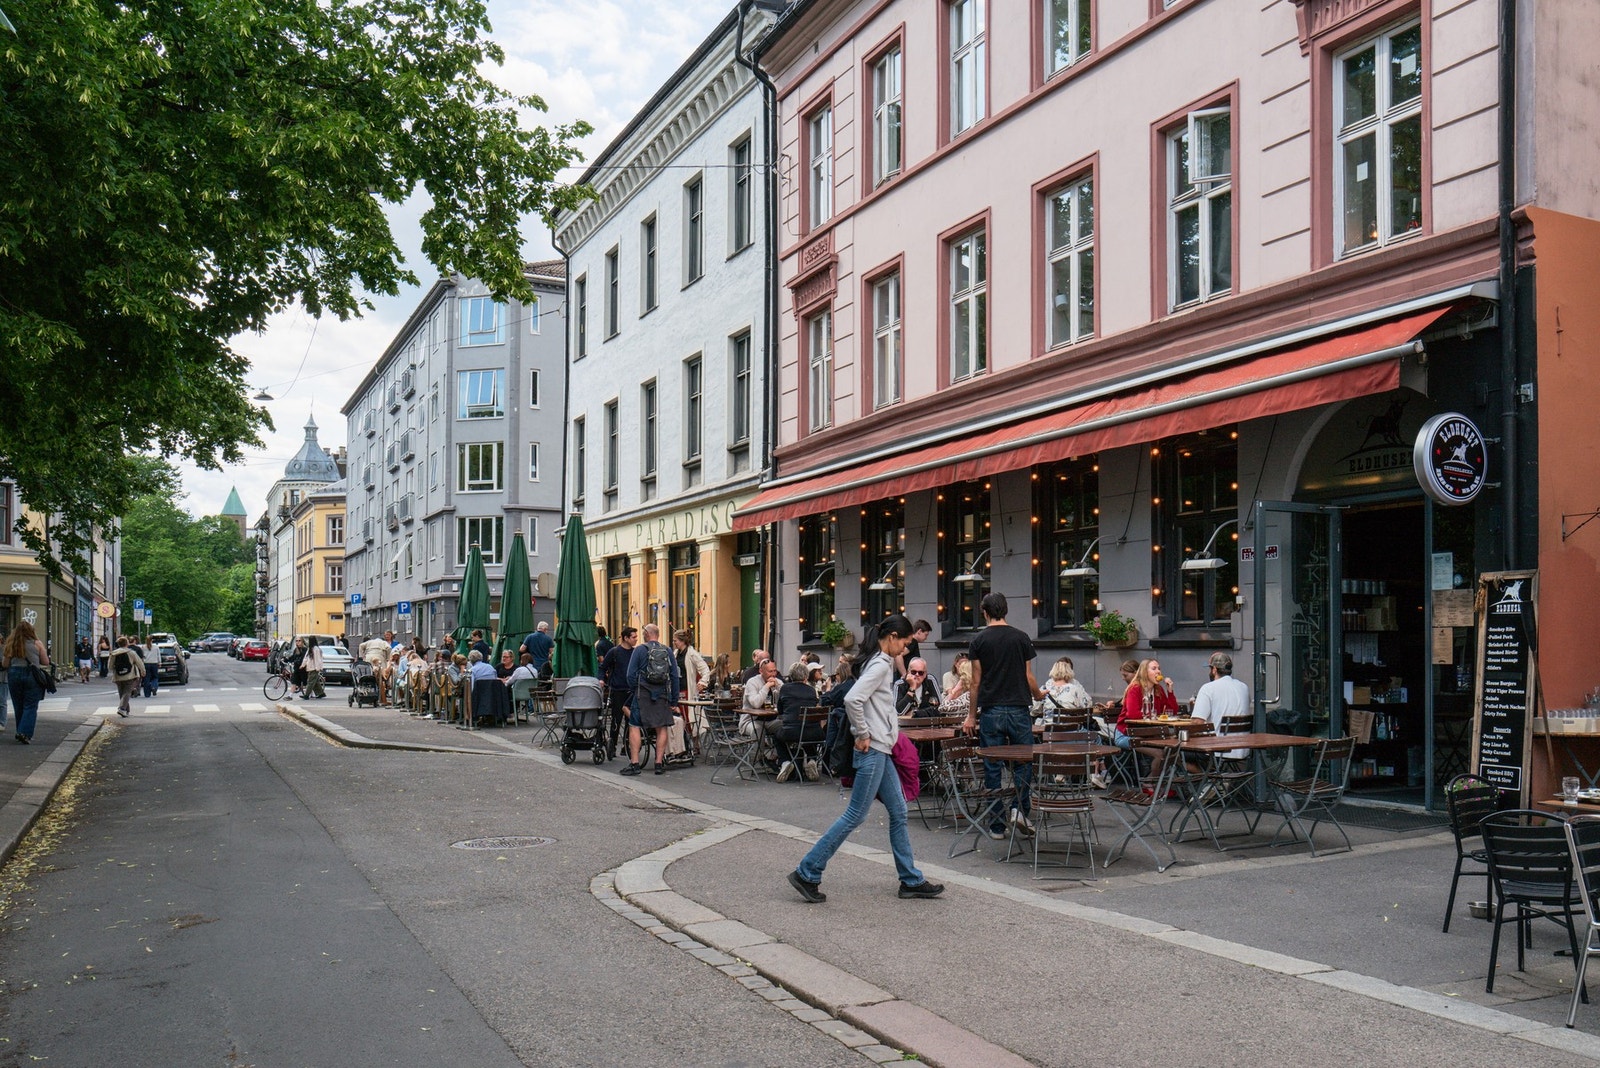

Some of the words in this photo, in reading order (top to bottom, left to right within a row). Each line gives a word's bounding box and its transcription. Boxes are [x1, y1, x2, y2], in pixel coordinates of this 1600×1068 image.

[1439, 422, 1480, 448] ELDHUSET
[589, 530, 620, 557] ILLA
[635, 500, 736, 549] PARADISO
[136, 600, 142, 609] P
[353, 595, 359, 604] P
[401, 602, 408, 613] P
